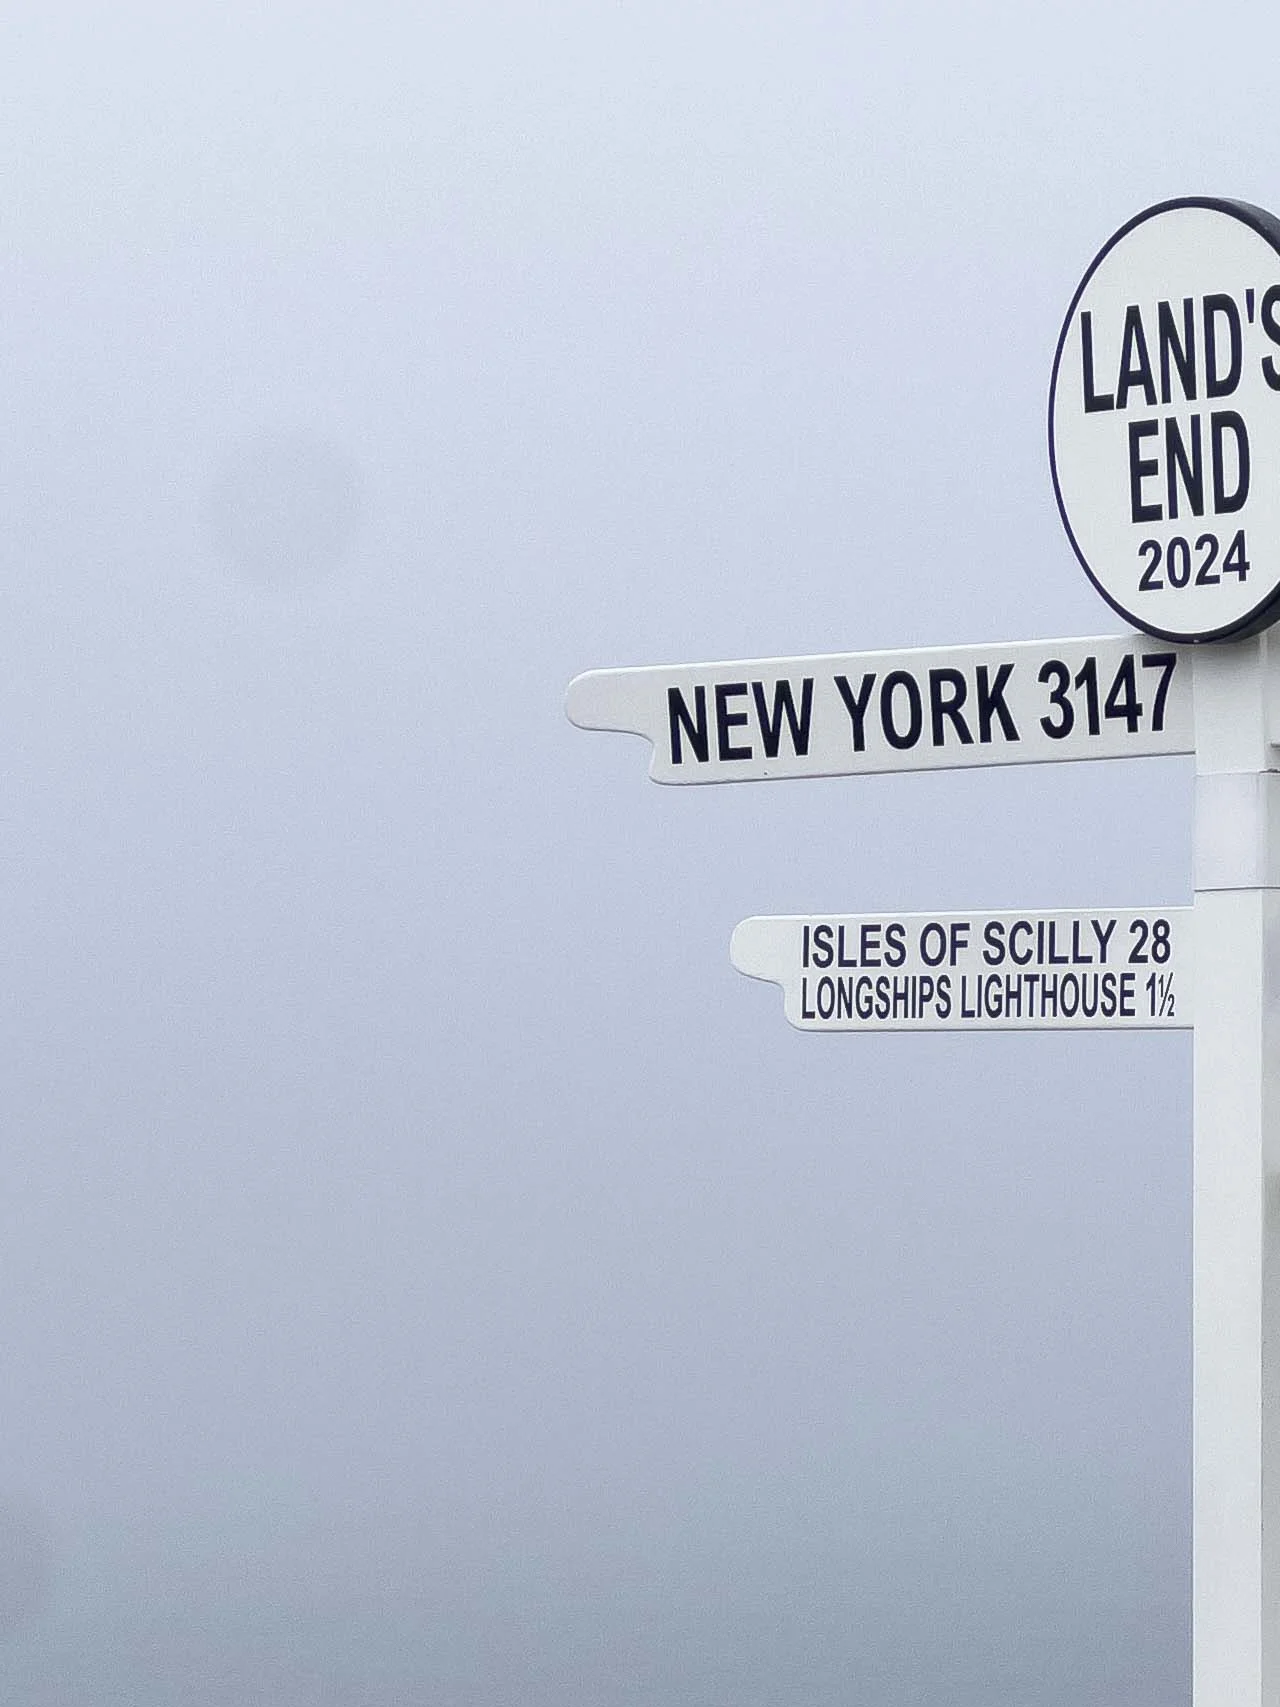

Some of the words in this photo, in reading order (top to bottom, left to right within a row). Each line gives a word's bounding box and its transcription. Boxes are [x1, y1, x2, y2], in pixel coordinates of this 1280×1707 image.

[1128, 410, 1250, 524] END
[1137, 529, 1251, 592] 2024
[667, 677, 814, 765] NEW
[833, 663, 1021, 753] YORK
[1037, 652, 1179, 740] 3147
[802, 923, 907, 969] ISLES
[919, 922, 971, 967] OF
[982, 919, 1117, 966] SCILLY
[1128, 918, 1171, 964] 28
[801, 974, 952, 1020] LONGSHIPS
[960, 972, 1136, 1019] LIGHTHOUSE
